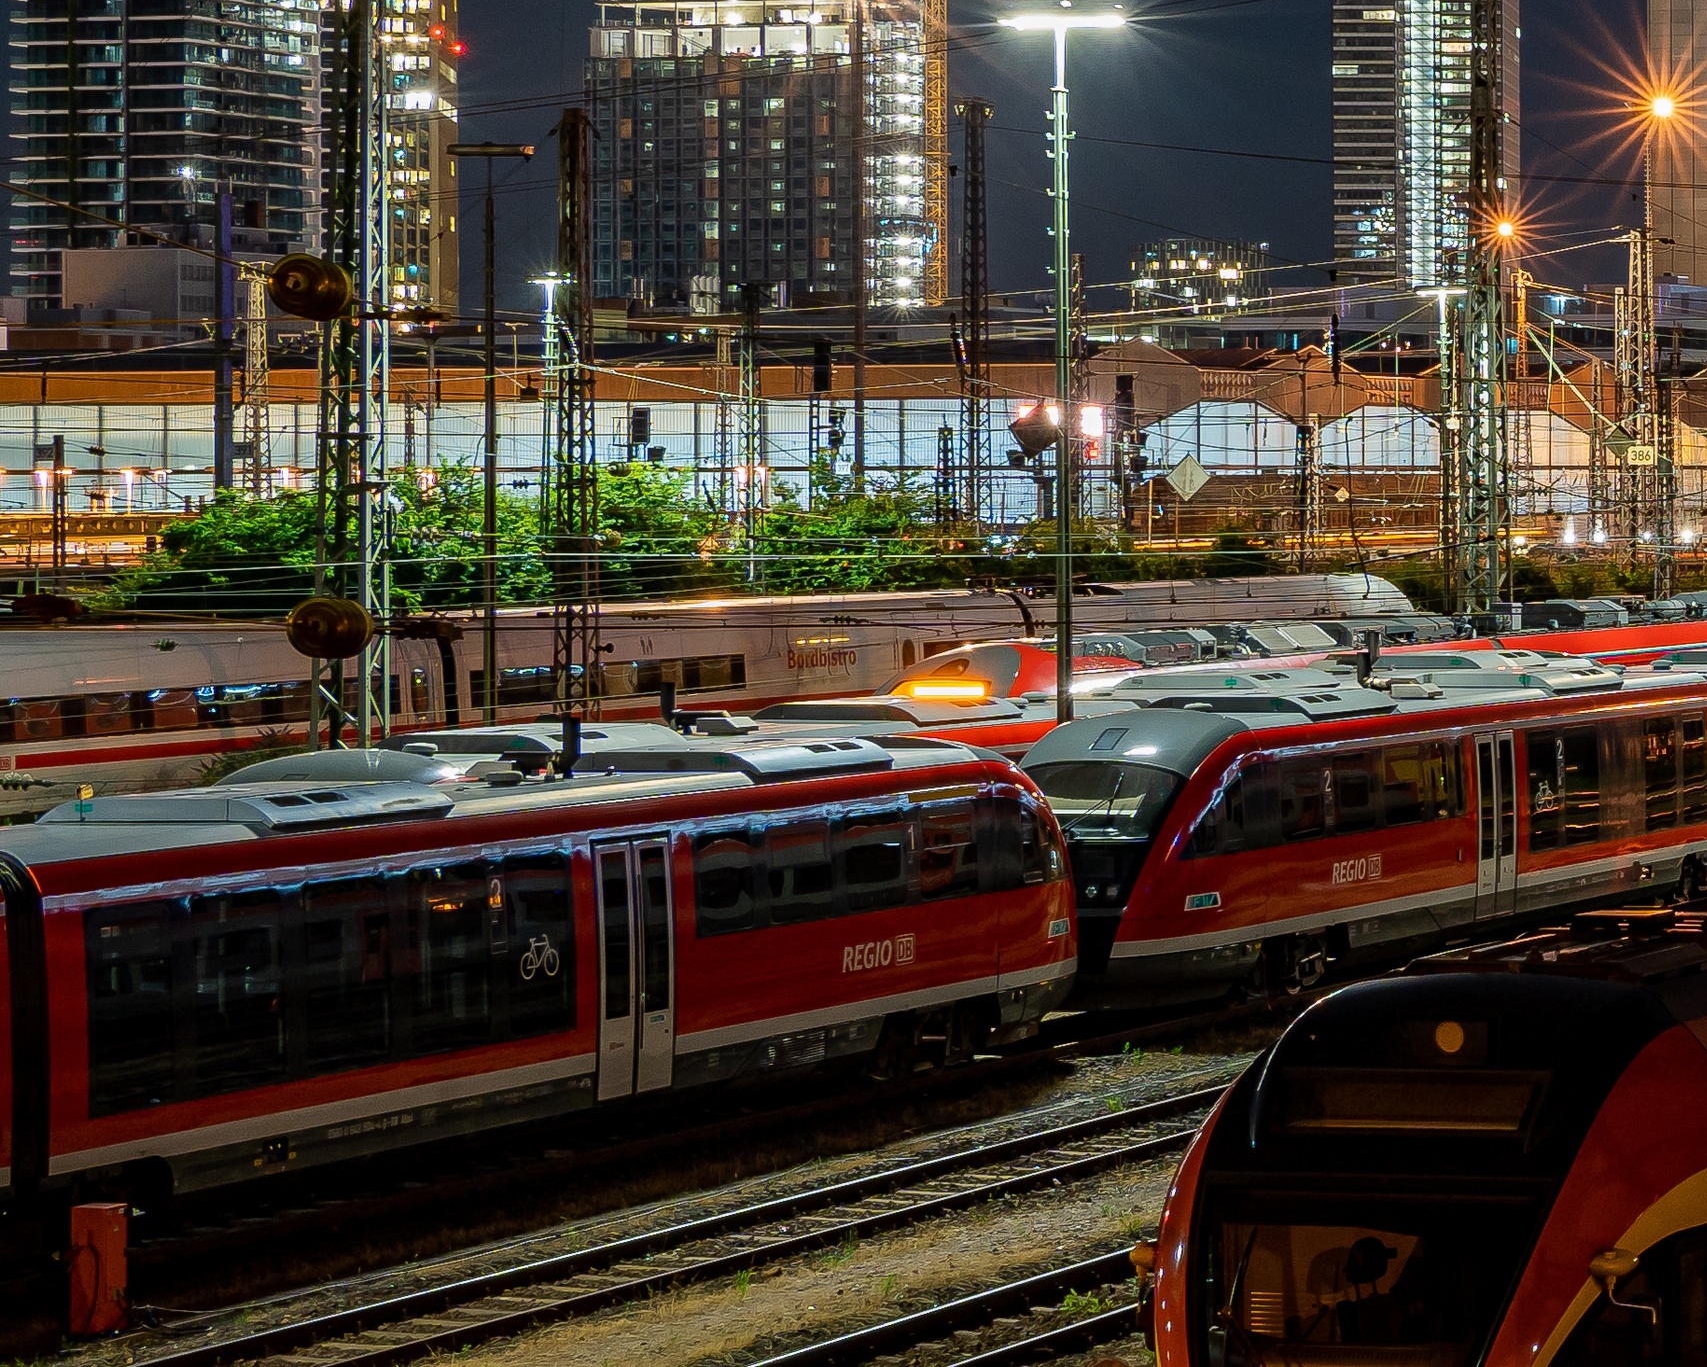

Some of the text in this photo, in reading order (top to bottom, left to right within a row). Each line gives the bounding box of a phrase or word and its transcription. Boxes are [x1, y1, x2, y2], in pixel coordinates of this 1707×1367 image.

[36, 445, 54, 459] 392
[234, 444, 252, 457] 391
[1630, 449, 1651, 462] 386
[787, 647, 857, 669] Bordbistro
[1323, 770, 1332, 792] 2
[1331, 857, 1367, 885] REGIO
[842, 936, 914, 973] REGIO DB
